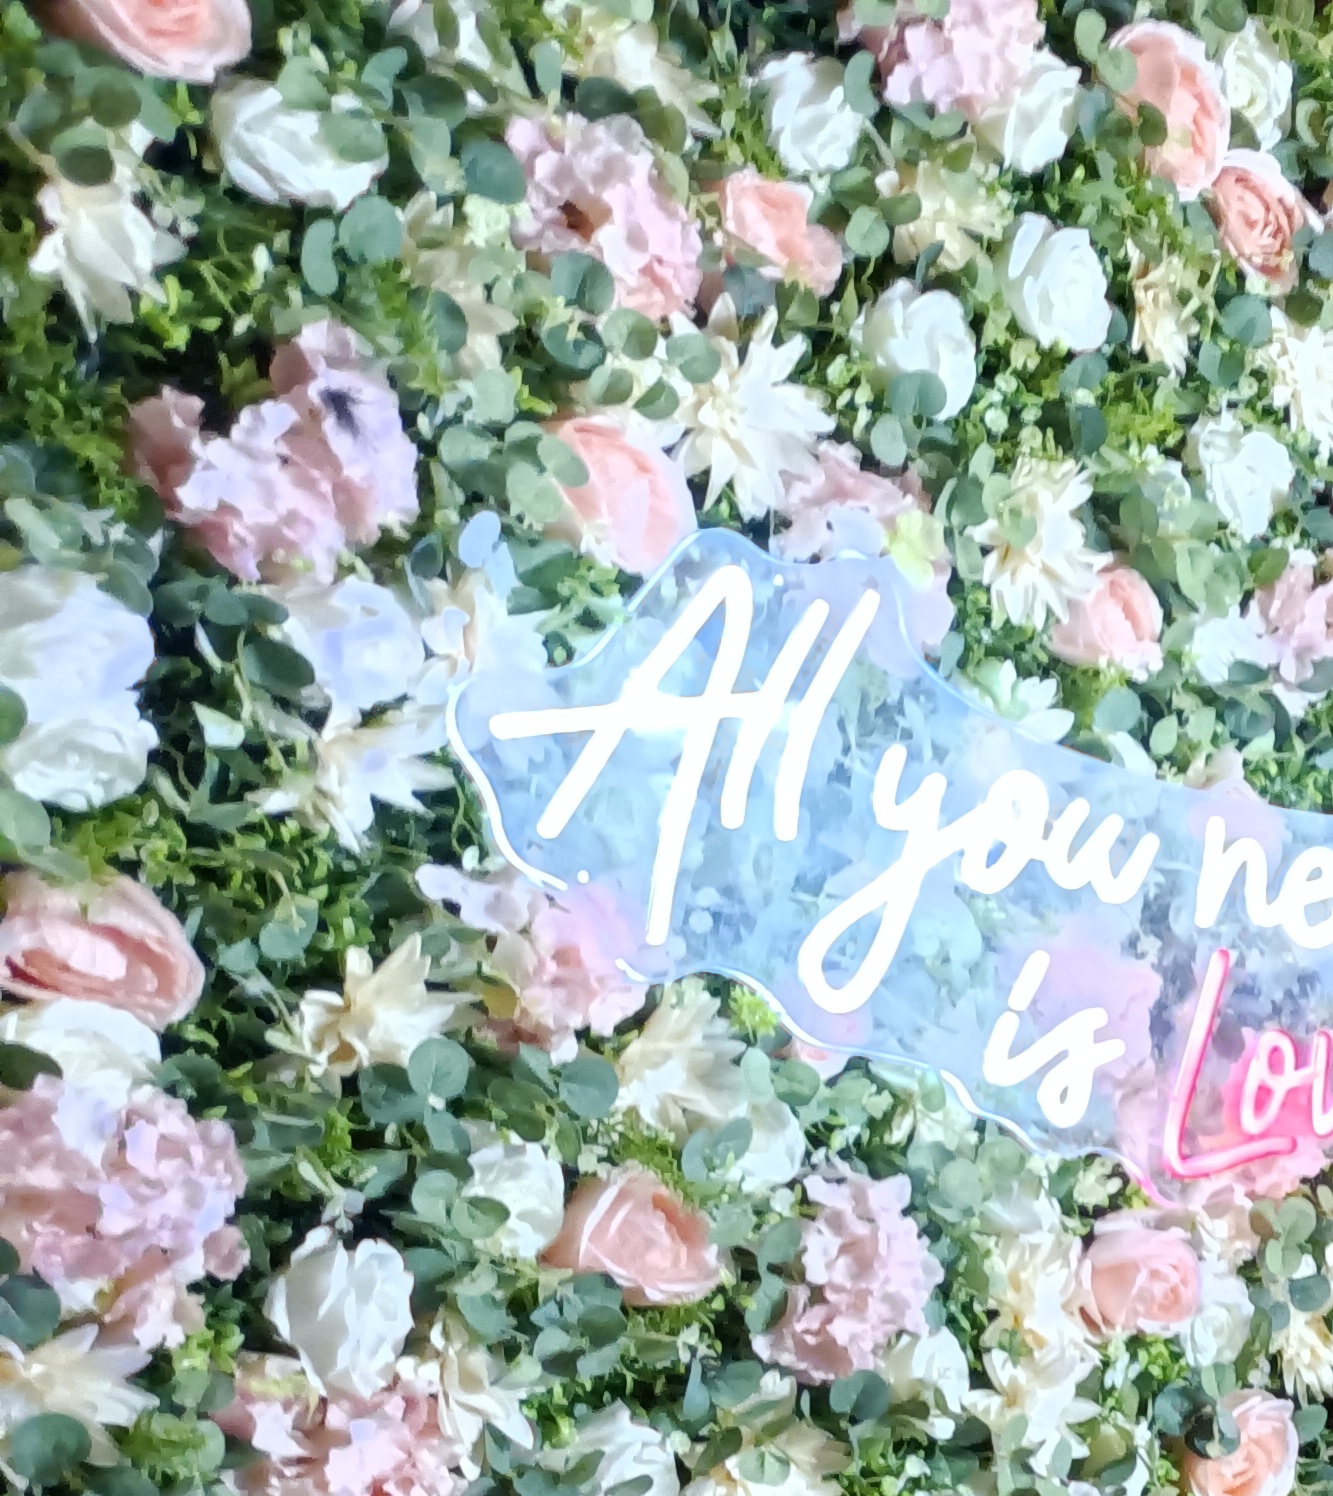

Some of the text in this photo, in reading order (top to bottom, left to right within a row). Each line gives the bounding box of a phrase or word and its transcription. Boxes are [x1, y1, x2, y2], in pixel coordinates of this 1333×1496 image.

[490, 565, 879, 945] All
[799, 742, 1158, 1014] you
[984, 951, 1126, 1128] is
